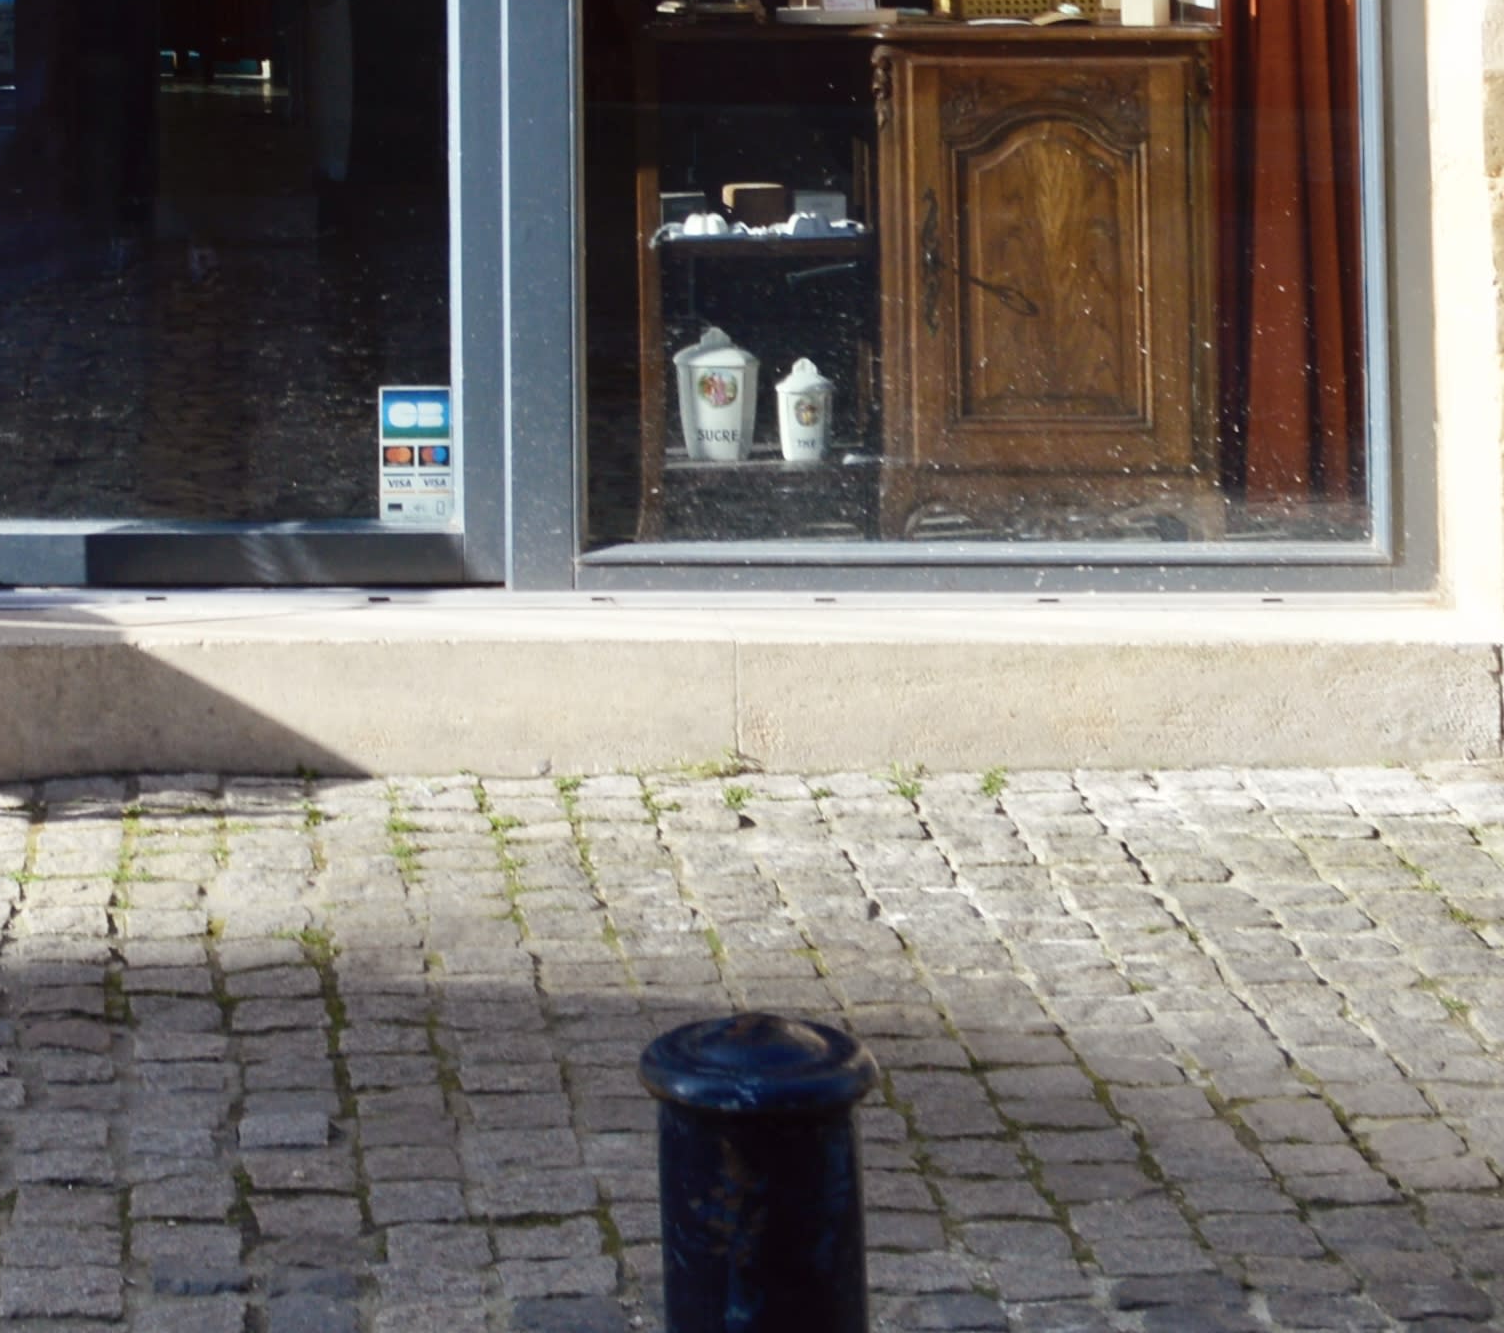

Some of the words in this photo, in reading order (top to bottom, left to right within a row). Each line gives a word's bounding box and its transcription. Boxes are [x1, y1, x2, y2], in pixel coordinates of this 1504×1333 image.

[696, 428, 740, 443] SUCRE
[387, 478, 413, 489] VISA
[423, 477, 447, 488] VISA
